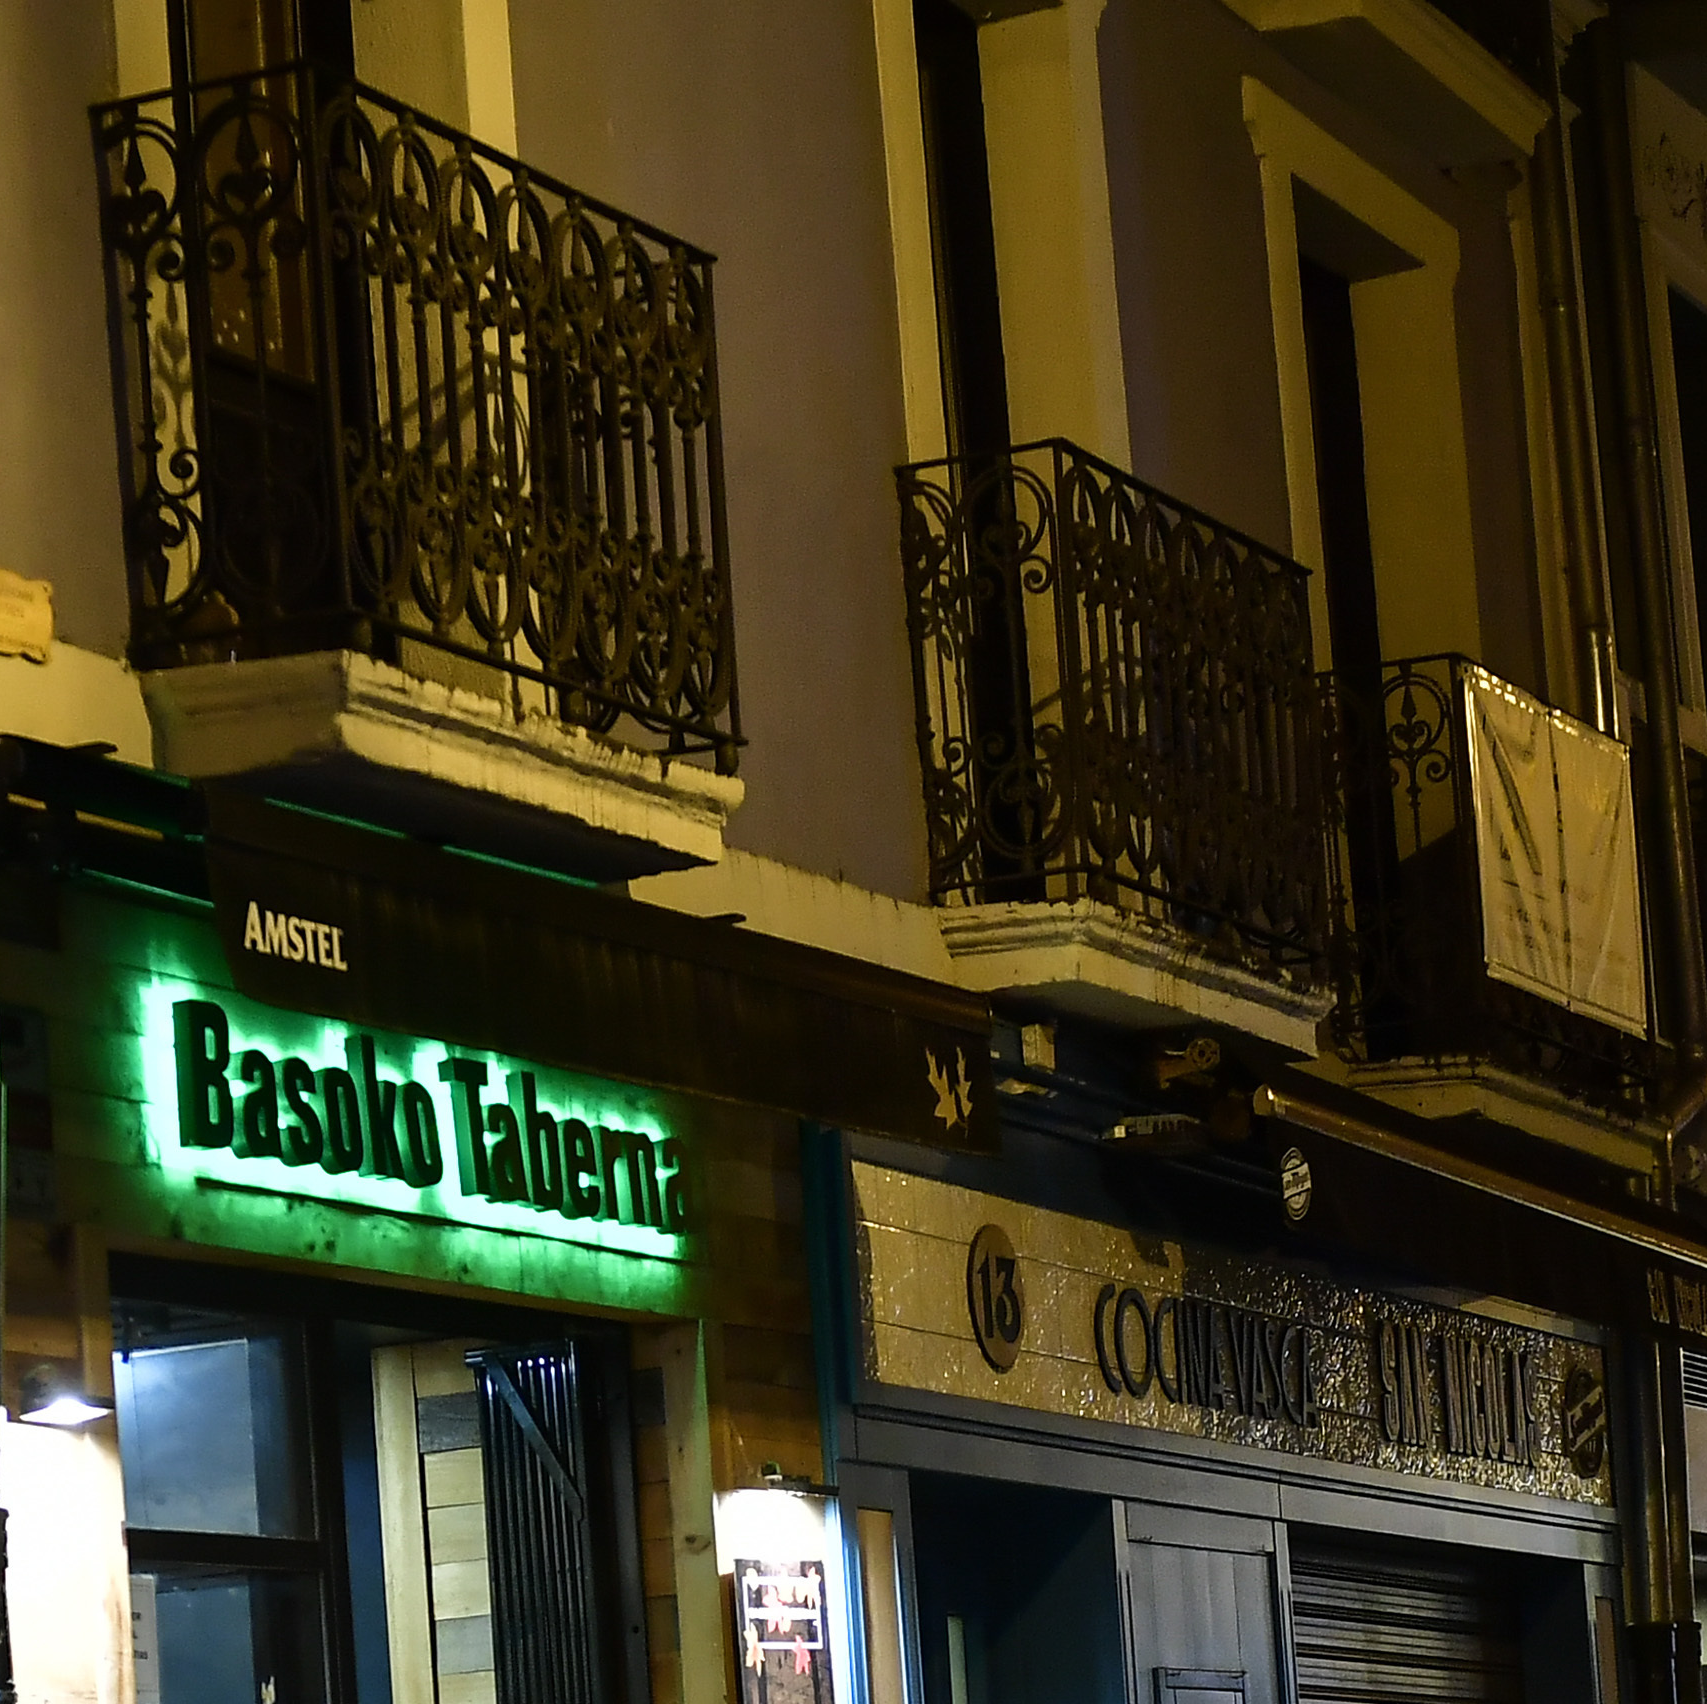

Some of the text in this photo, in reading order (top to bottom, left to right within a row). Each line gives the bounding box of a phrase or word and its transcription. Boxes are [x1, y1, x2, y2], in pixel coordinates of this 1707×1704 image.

[244, 900, 347, 971] AMSTEL
[173, 998, 689, 1234] Basoko Taberna
[976, 1253, 1022, 1343] 13
